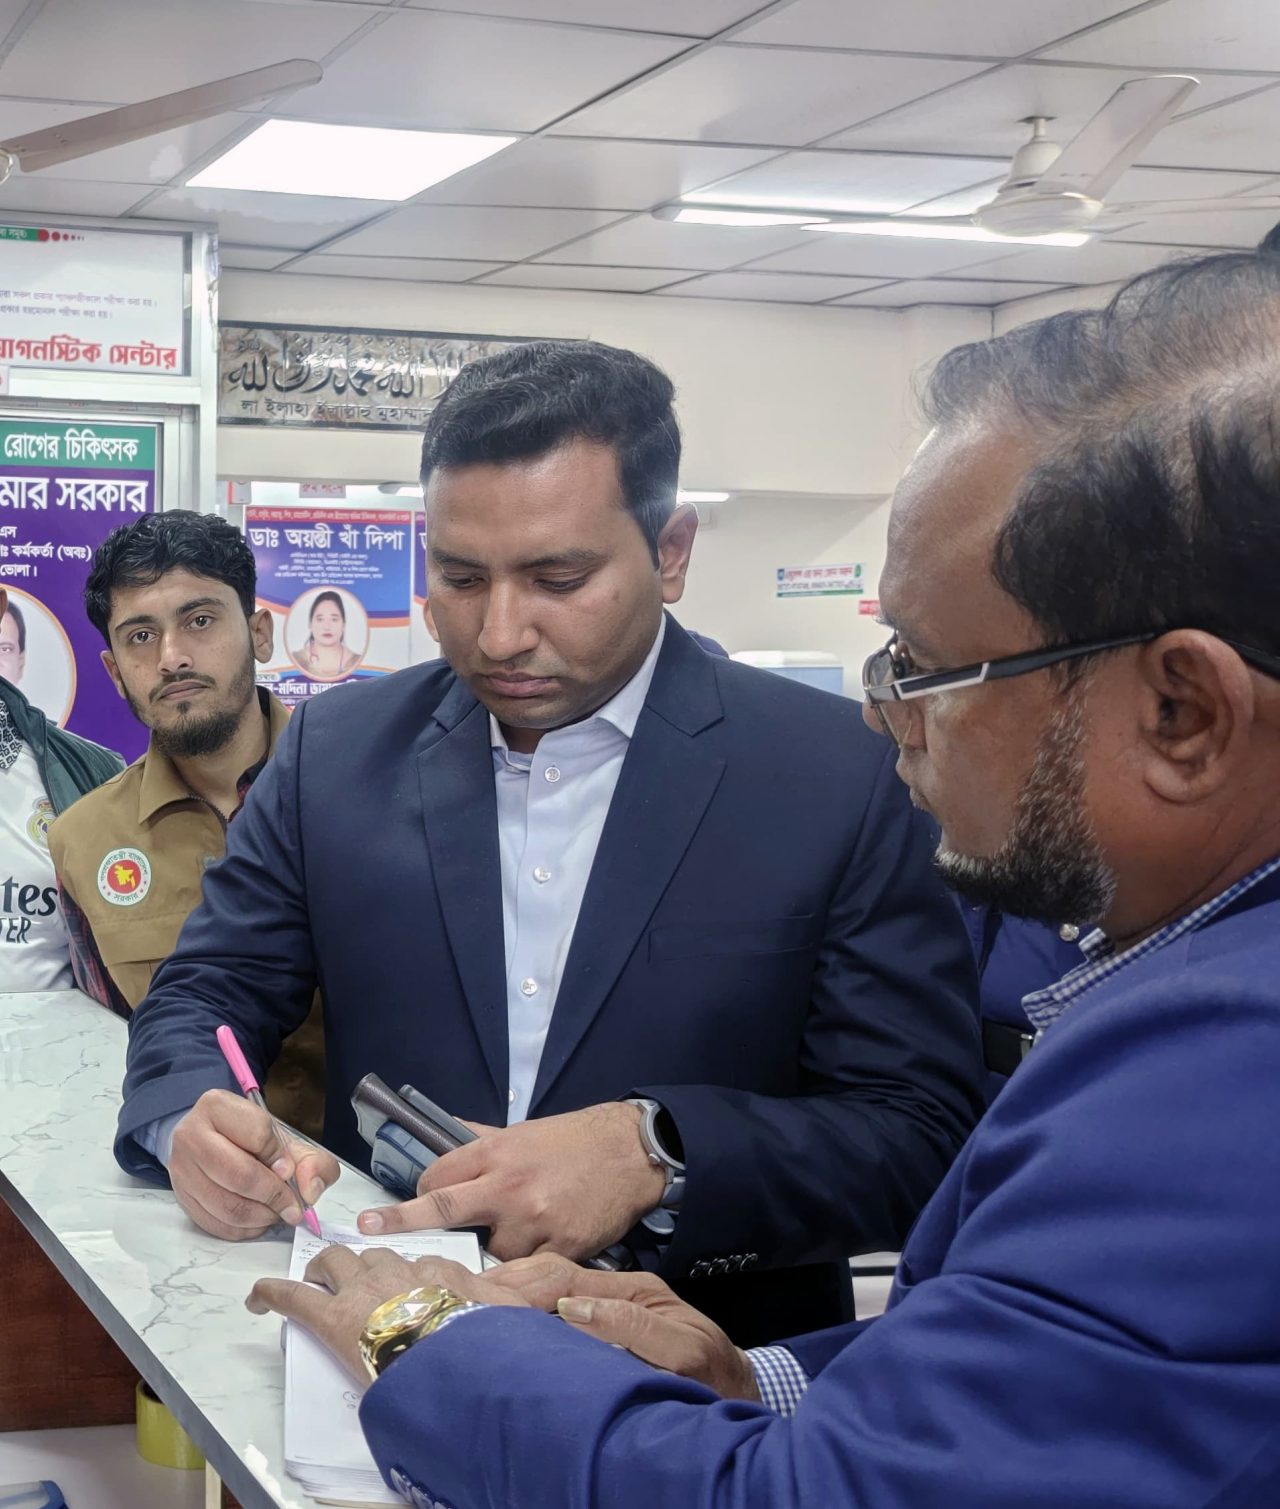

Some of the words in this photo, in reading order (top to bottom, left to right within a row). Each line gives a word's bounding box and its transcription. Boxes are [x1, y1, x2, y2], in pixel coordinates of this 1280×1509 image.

[108, 341, 178, 369] সেন্টার
[4, 433, 60, 461] রোগের
[64, 428, 139, 462] চিকিৎসক
[56, 477, 149, 513] সরকার
[248, 528, 280, 548] ডাঃ
[364, 524, 406, 551] দিপা
[12, 544, 54, 560] কর্মকর্তা
